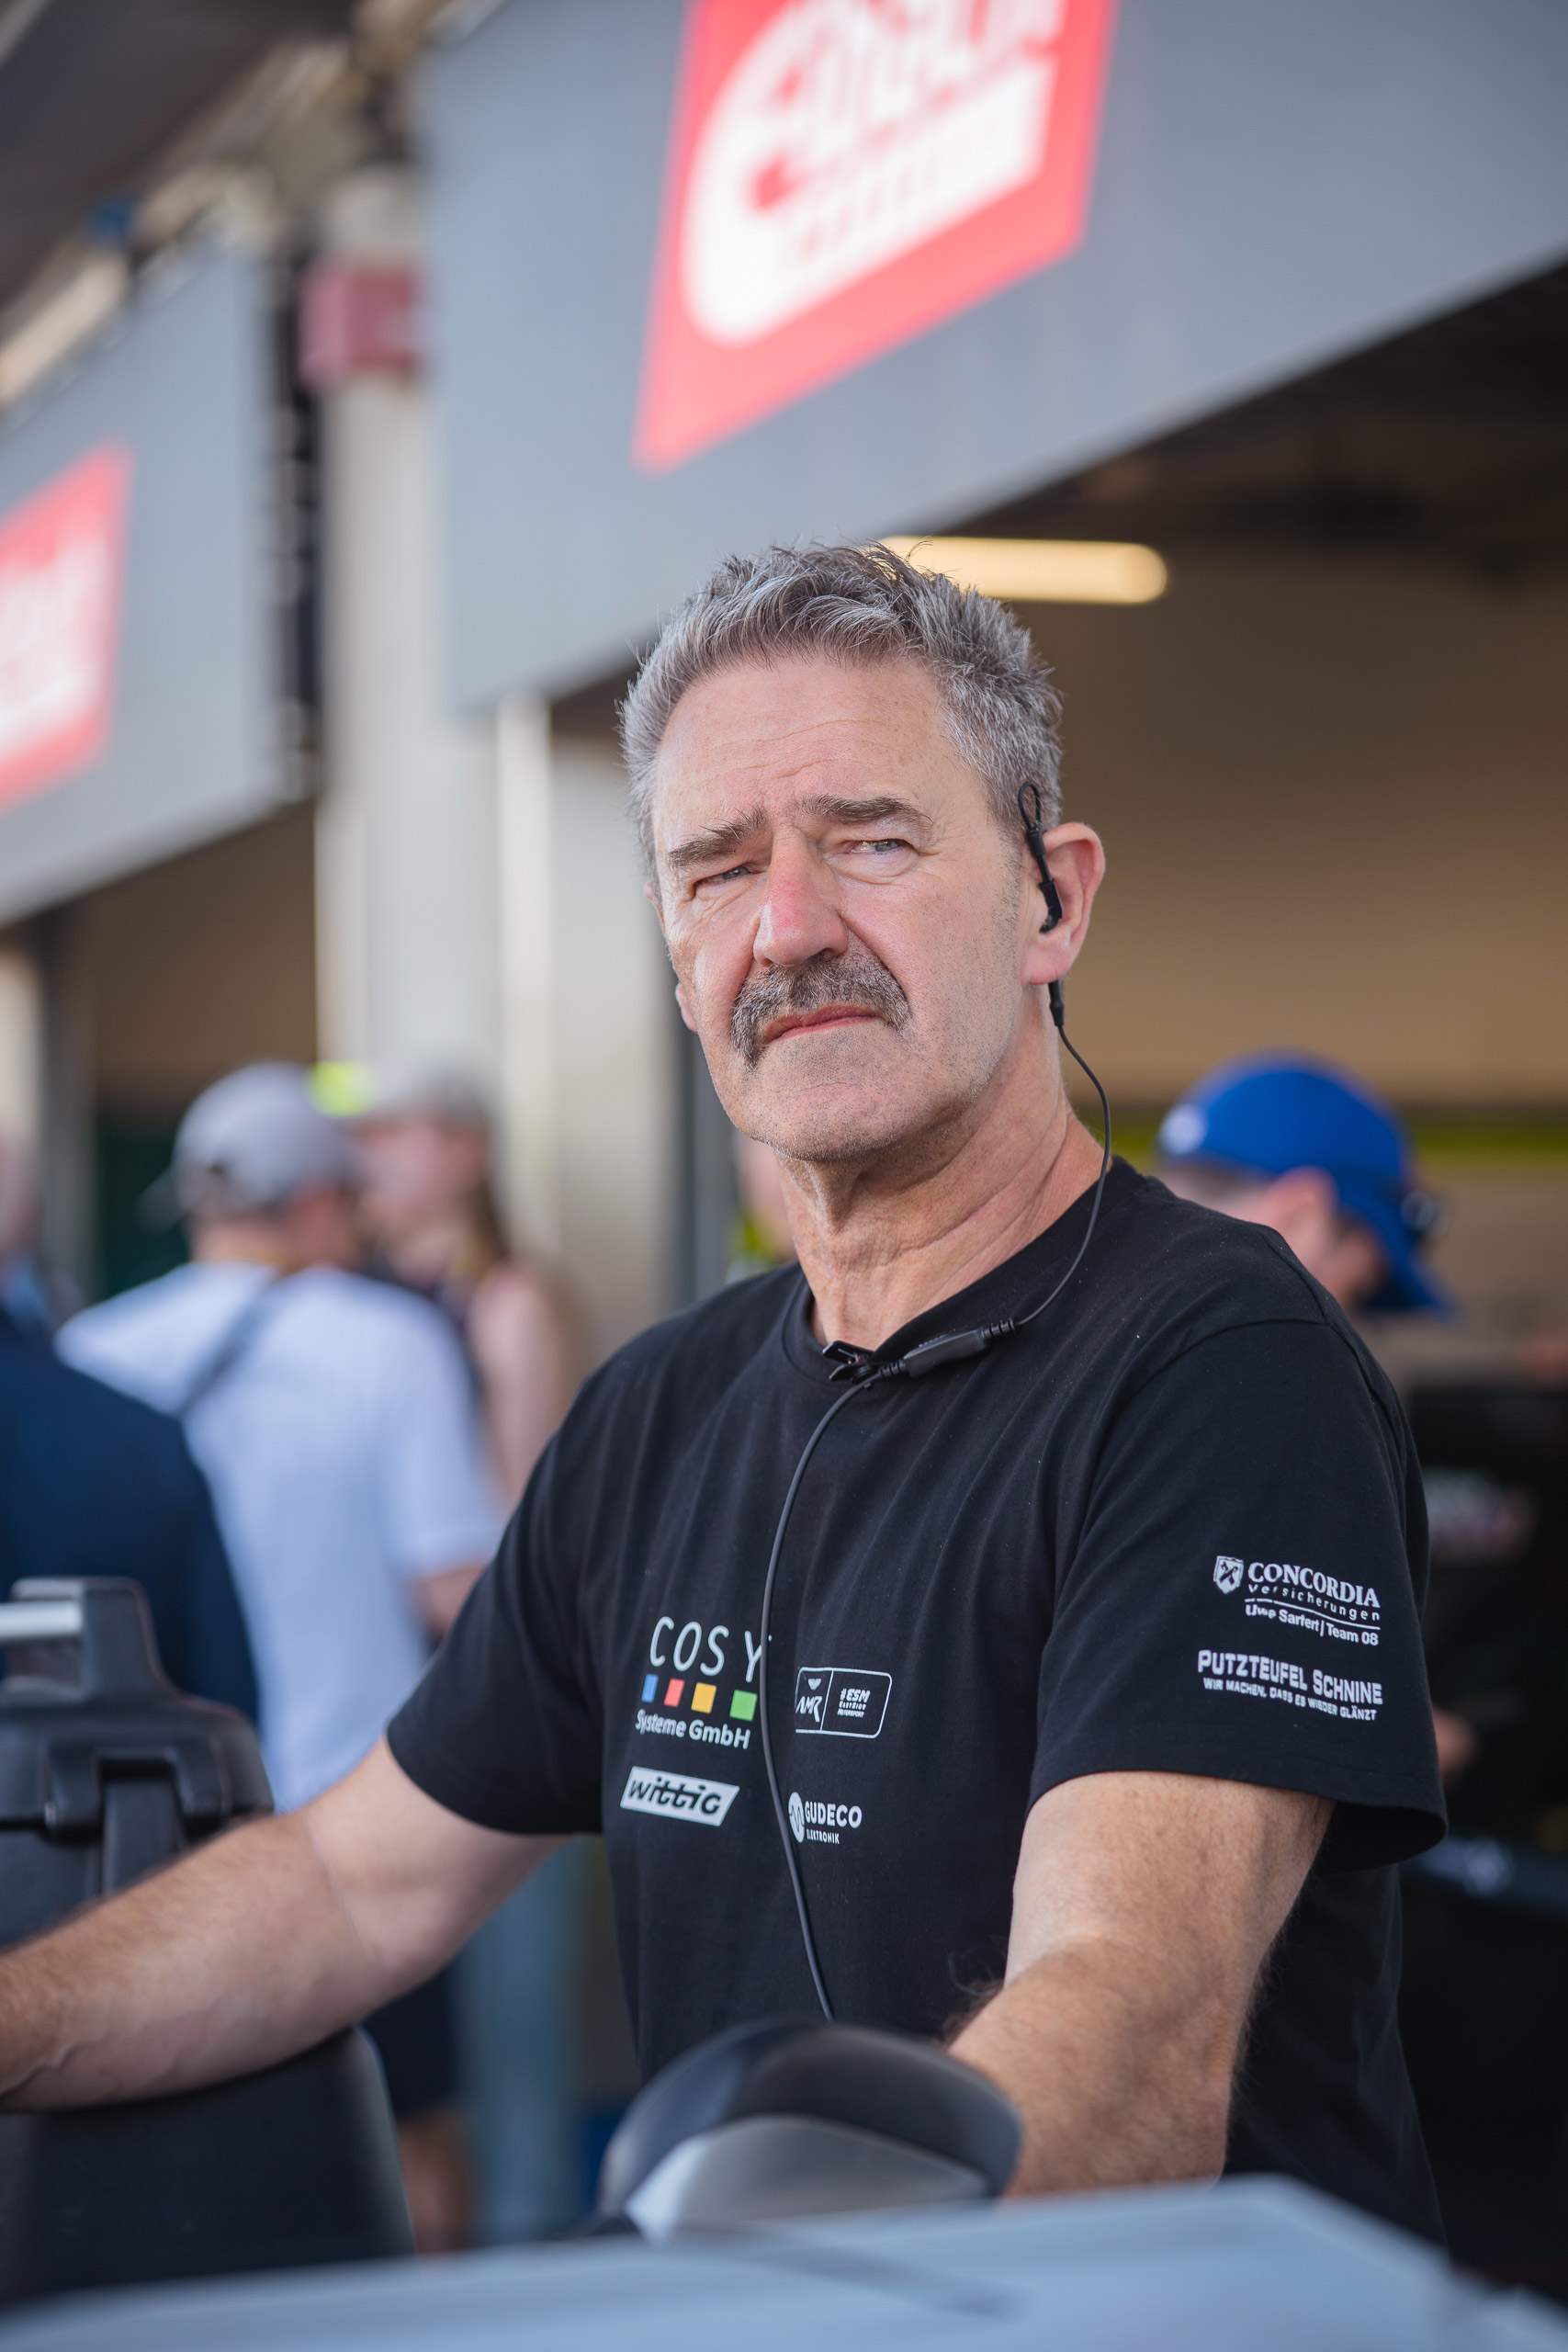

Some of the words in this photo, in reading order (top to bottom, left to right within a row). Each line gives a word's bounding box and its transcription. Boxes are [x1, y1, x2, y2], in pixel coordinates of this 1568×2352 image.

[1247, 1562, 1381, 1608] CONCORDIA
[1245, 1603, 1277, 1619] Uwe
[1325, 1622, 1359, 1643] Team
[1360, 1631, 1379, 1645] 08
[1202, 1678, 1224, 1690] WIR
[1269, 1687, 1293, 1703] DASS
[1294, 1694, 1306, 1707] ES
[1307, 1697, 1337, 1716] WIEDER
[1339, 1705, 1377, 1721] GLÄNZT
[635, 1709, 687, 1738] Systeme
[688, 1719, 751, 1749] GmbH
[804, 1800, 863, 1829] GUDECO
